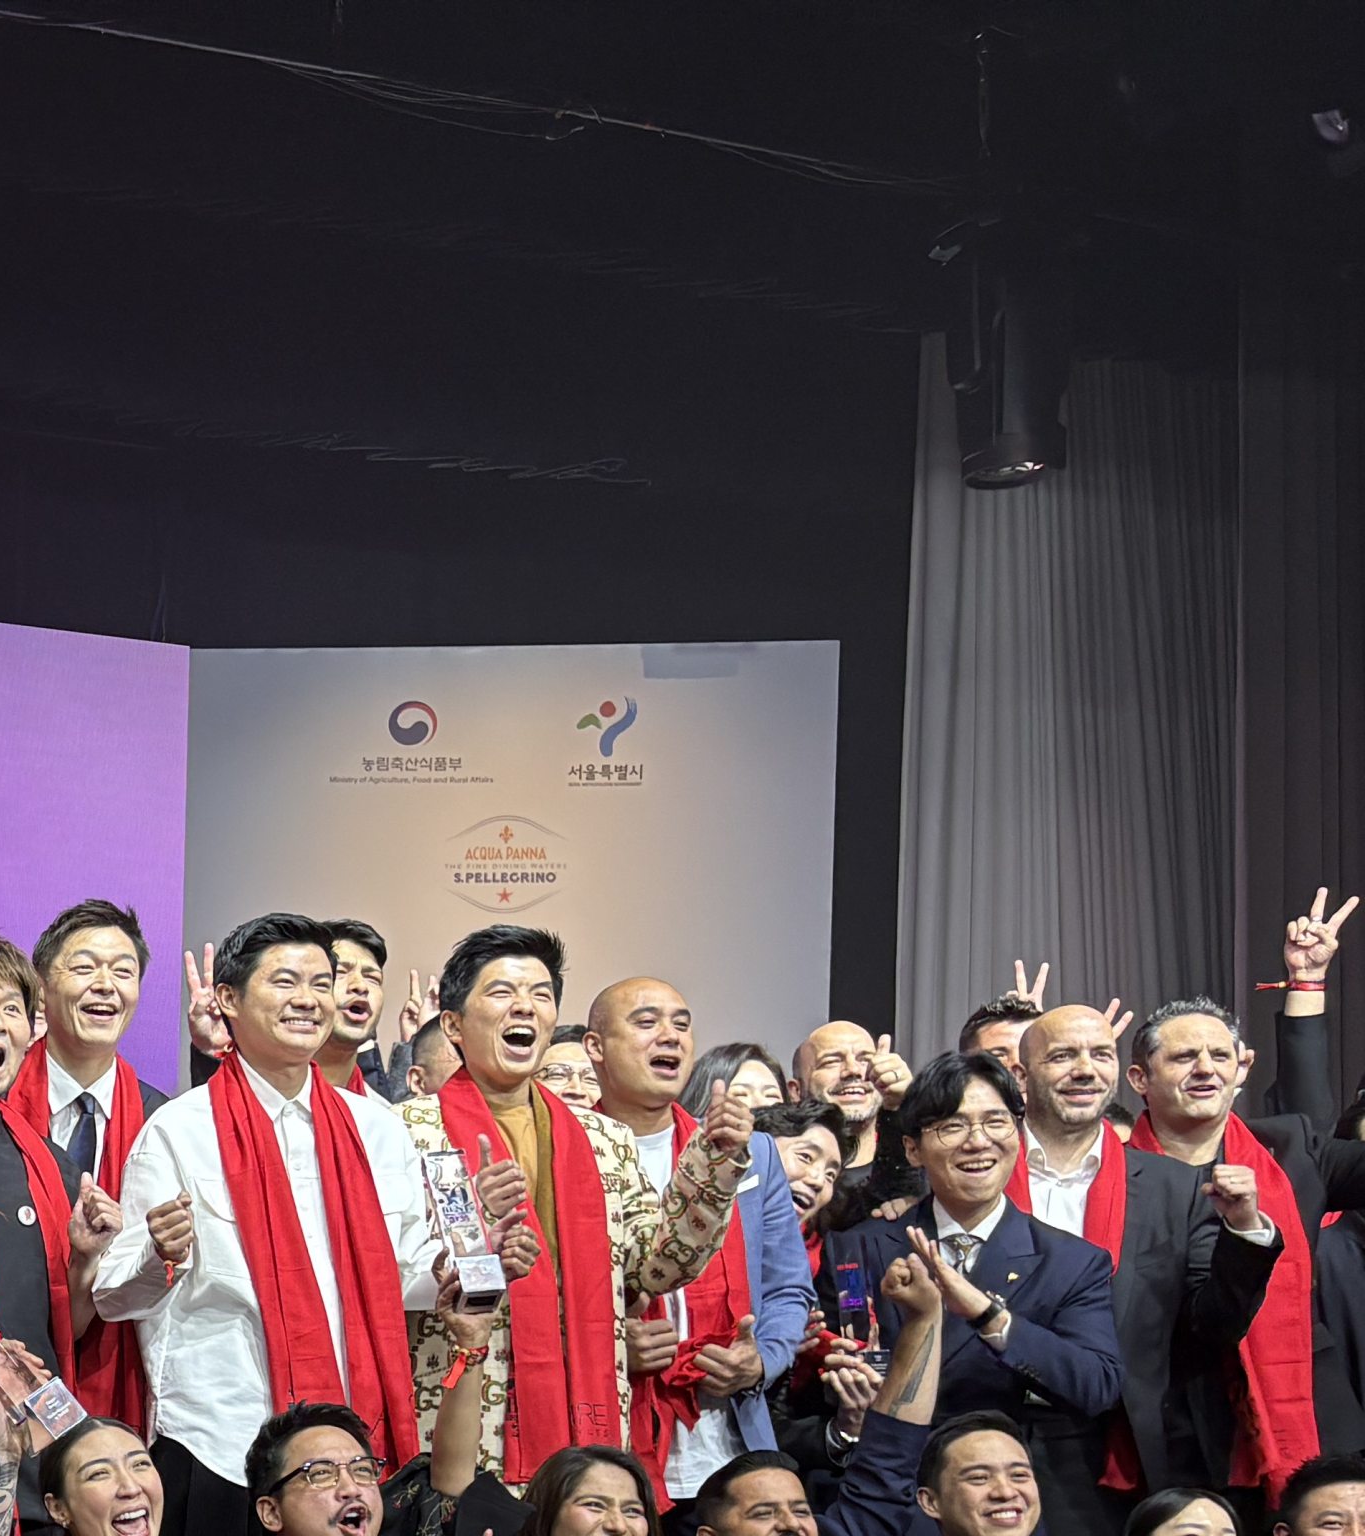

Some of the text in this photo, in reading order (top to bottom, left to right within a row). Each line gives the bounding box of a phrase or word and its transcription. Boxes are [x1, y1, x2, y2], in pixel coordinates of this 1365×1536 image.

[361, 756, 463, 772] 농림축산식품부
[567, 763, 643, 781] 서울특별시
[464, 845, 547, 861] ACQUA PANNA
[453, 871, 557, 884] S.PELLEGRINO
